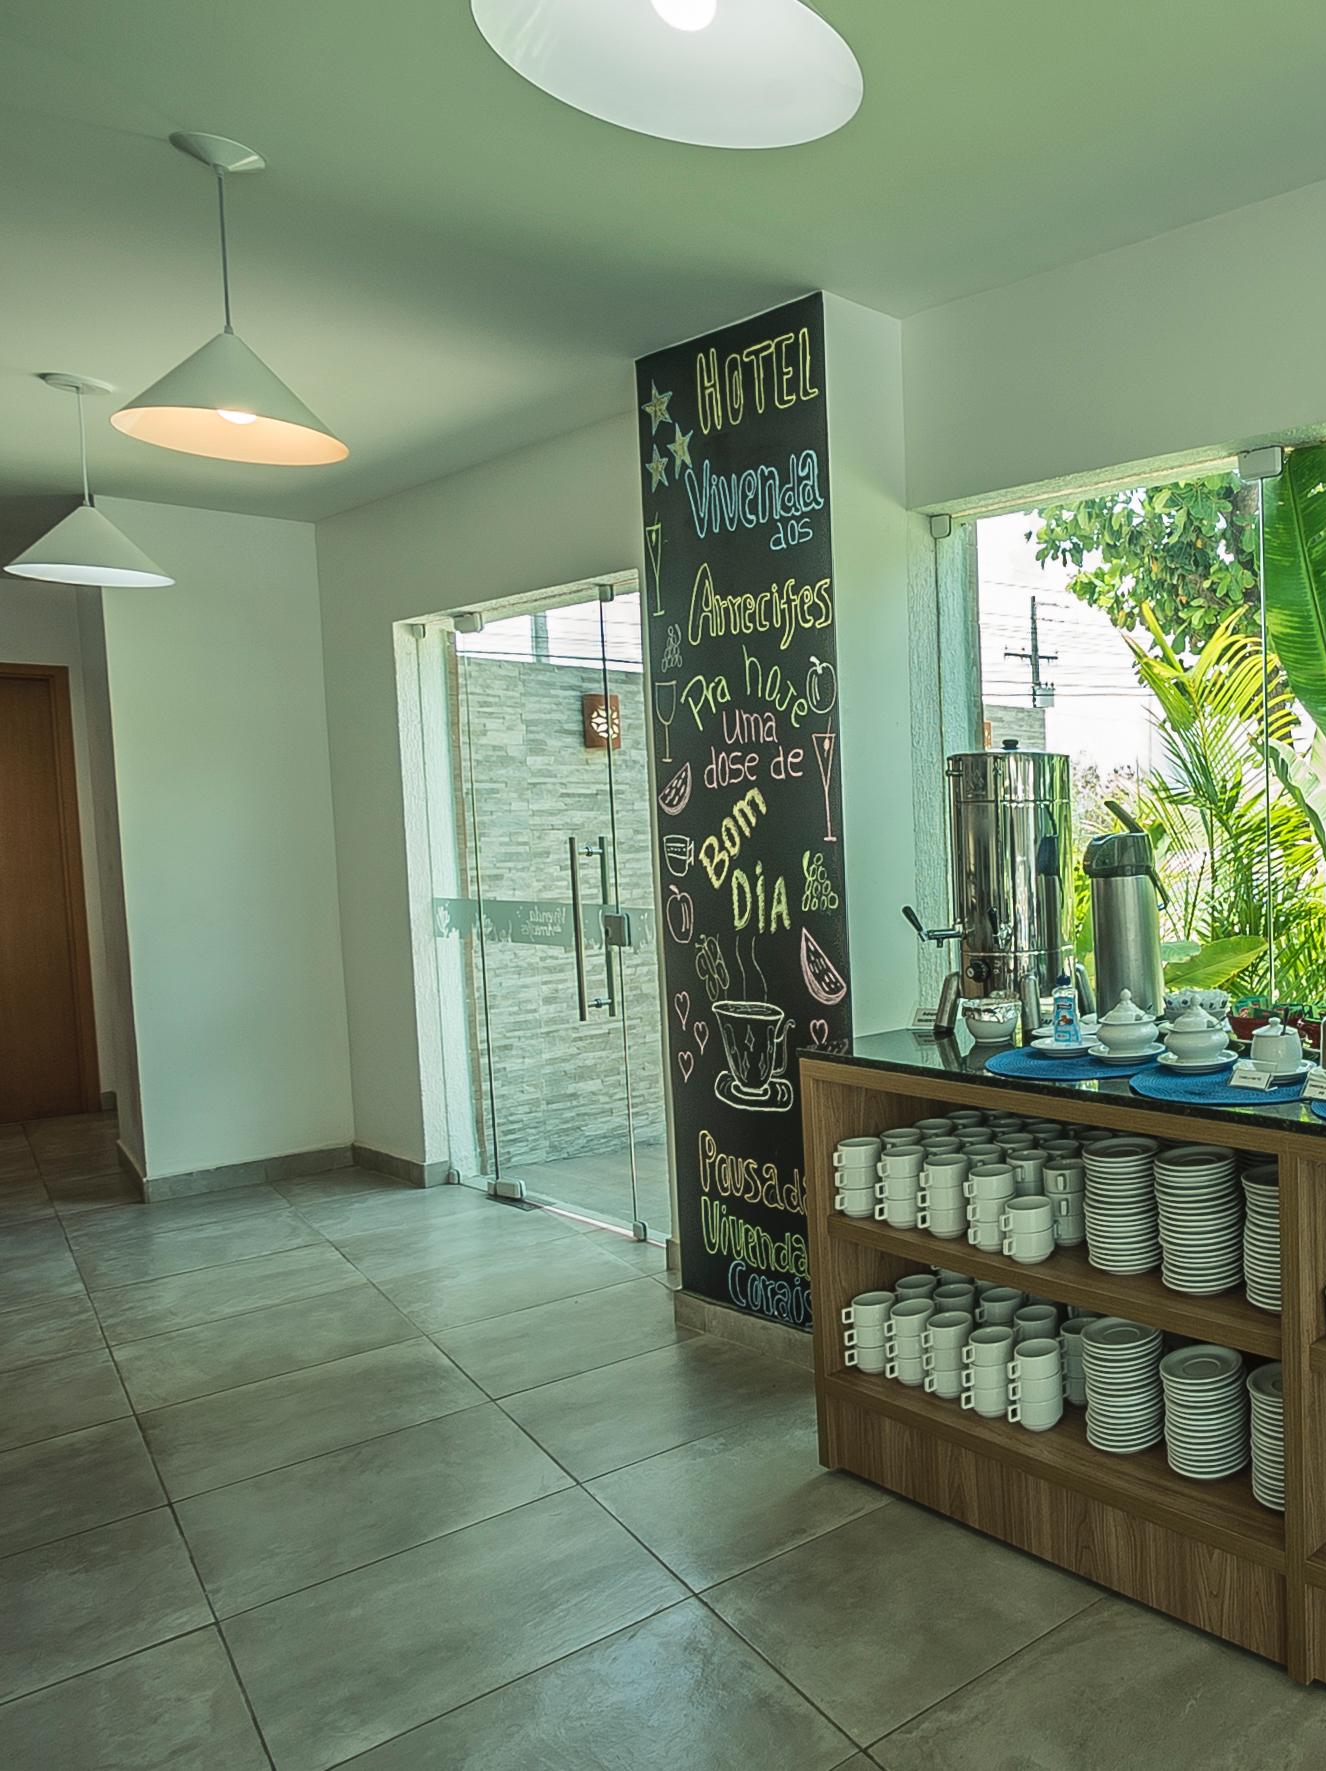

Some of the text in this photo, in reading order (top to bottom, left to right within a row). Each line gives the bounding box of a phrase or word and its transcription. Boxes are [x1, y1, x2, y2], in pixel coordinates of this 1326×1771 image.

[697, 327, 819, 435] HOTEL
[685, 450, 824, 538] Vivenda
[769, 518, 813, 550] dos
[688, 562, 832, 650] Arrecifes
[680, 674, 731, 731] Pra
[722, 708, 778, 745] uma
[704, 745, 804, 789] dose de
[699, 1130, 808, 1216] Pousad
[701, 1196, 811, 1281] Vivenda
